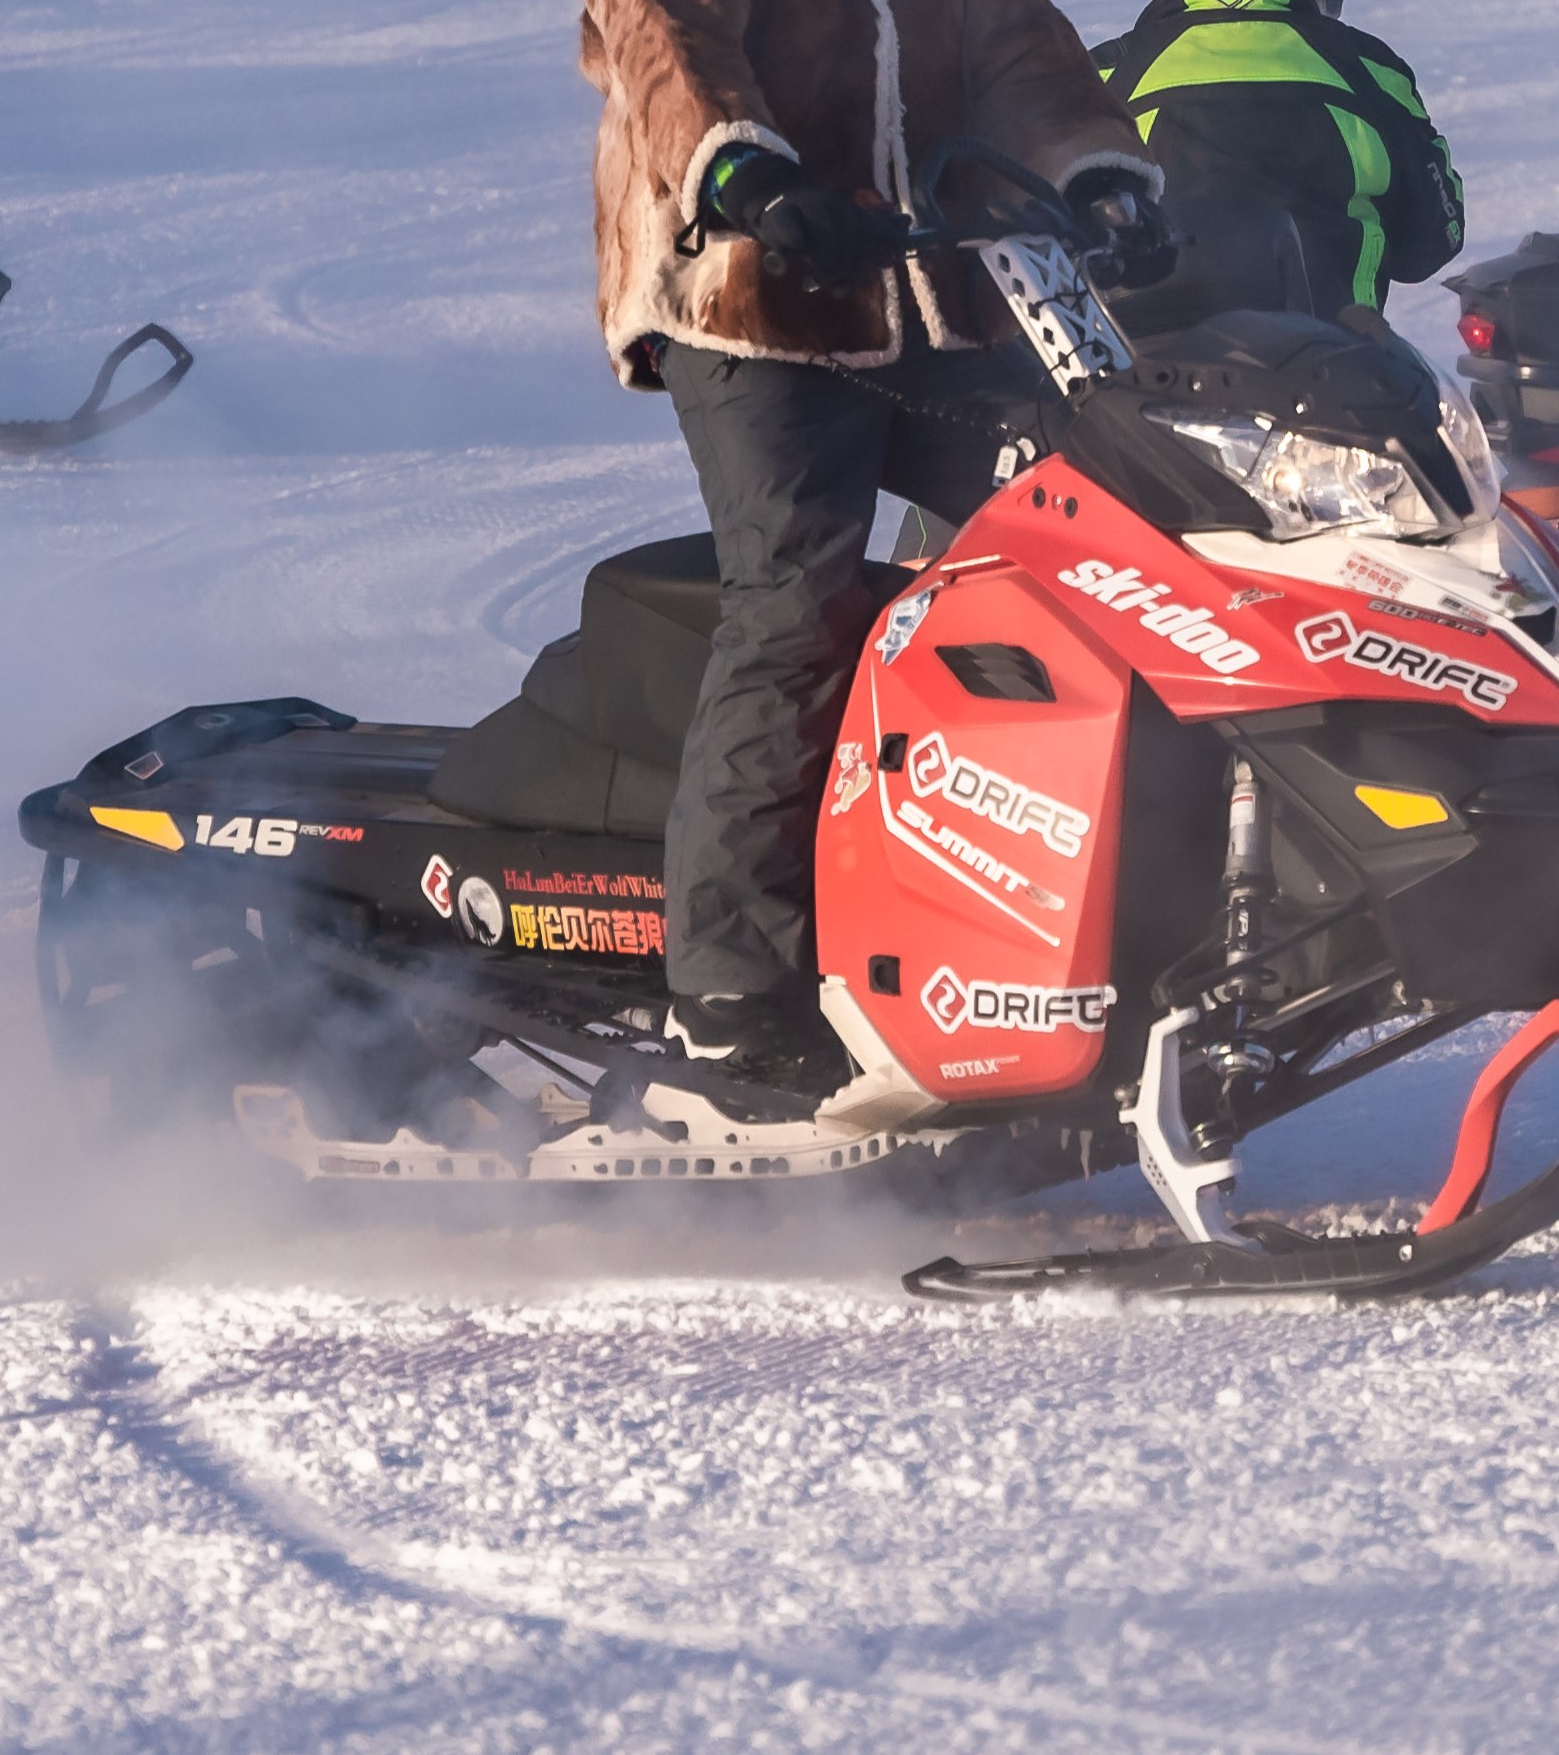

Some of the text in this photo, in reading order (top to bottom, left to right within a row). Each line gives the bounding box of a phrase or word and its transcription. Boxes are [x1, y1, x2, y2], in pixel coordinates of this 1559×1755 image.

[1057, 559, 1261, 675] ski-doo
[195, 814, 298, 857] 146
[897, 800, 1030, 894] SUMMIT
[510, 903, 668, 956] 呼伦贝尔苍狼
[939, 1058, 999, 1082] ROTAX
